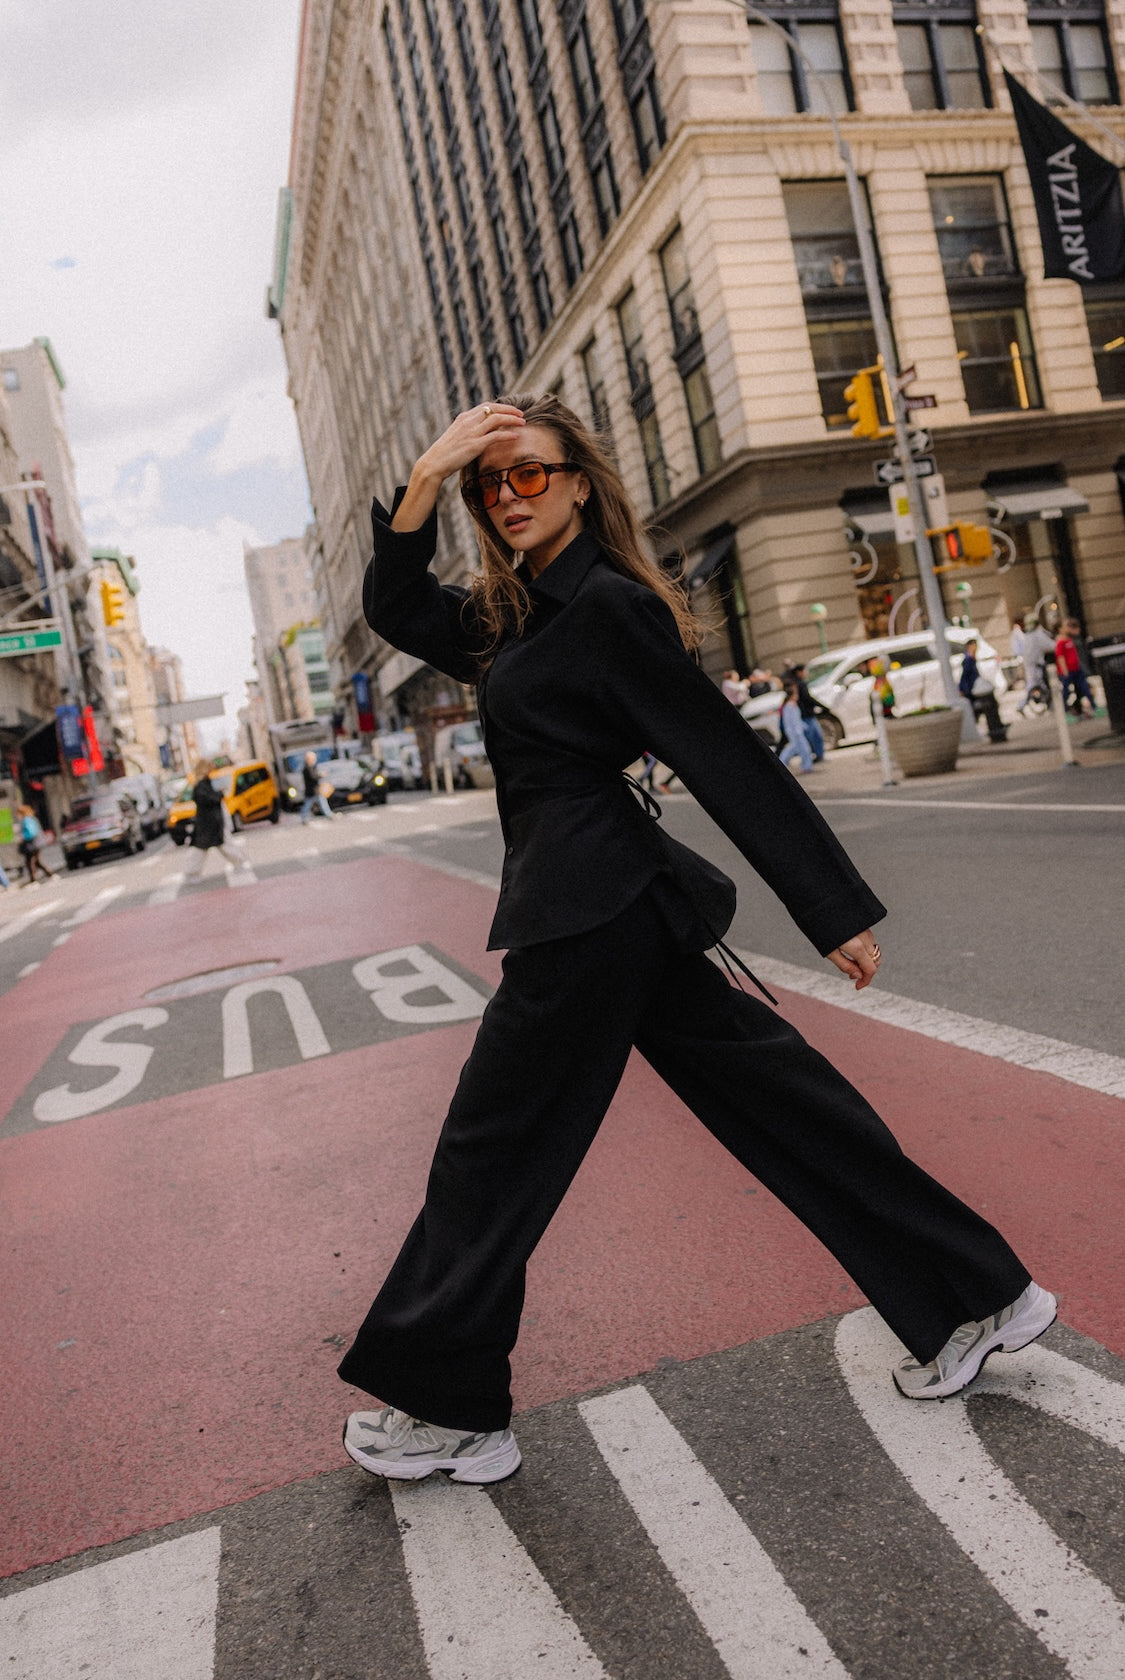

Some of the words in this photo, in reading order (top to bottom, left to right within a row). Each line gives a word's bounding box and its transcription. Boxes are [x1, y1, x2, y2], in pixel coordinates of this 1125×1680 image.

[1046, 143, 1095, 280] ARITZIA
[33, 944, 490, 1122] BUS
[949, 1327, 978, 1347] N
[411, 1429, 439, 1449] N
